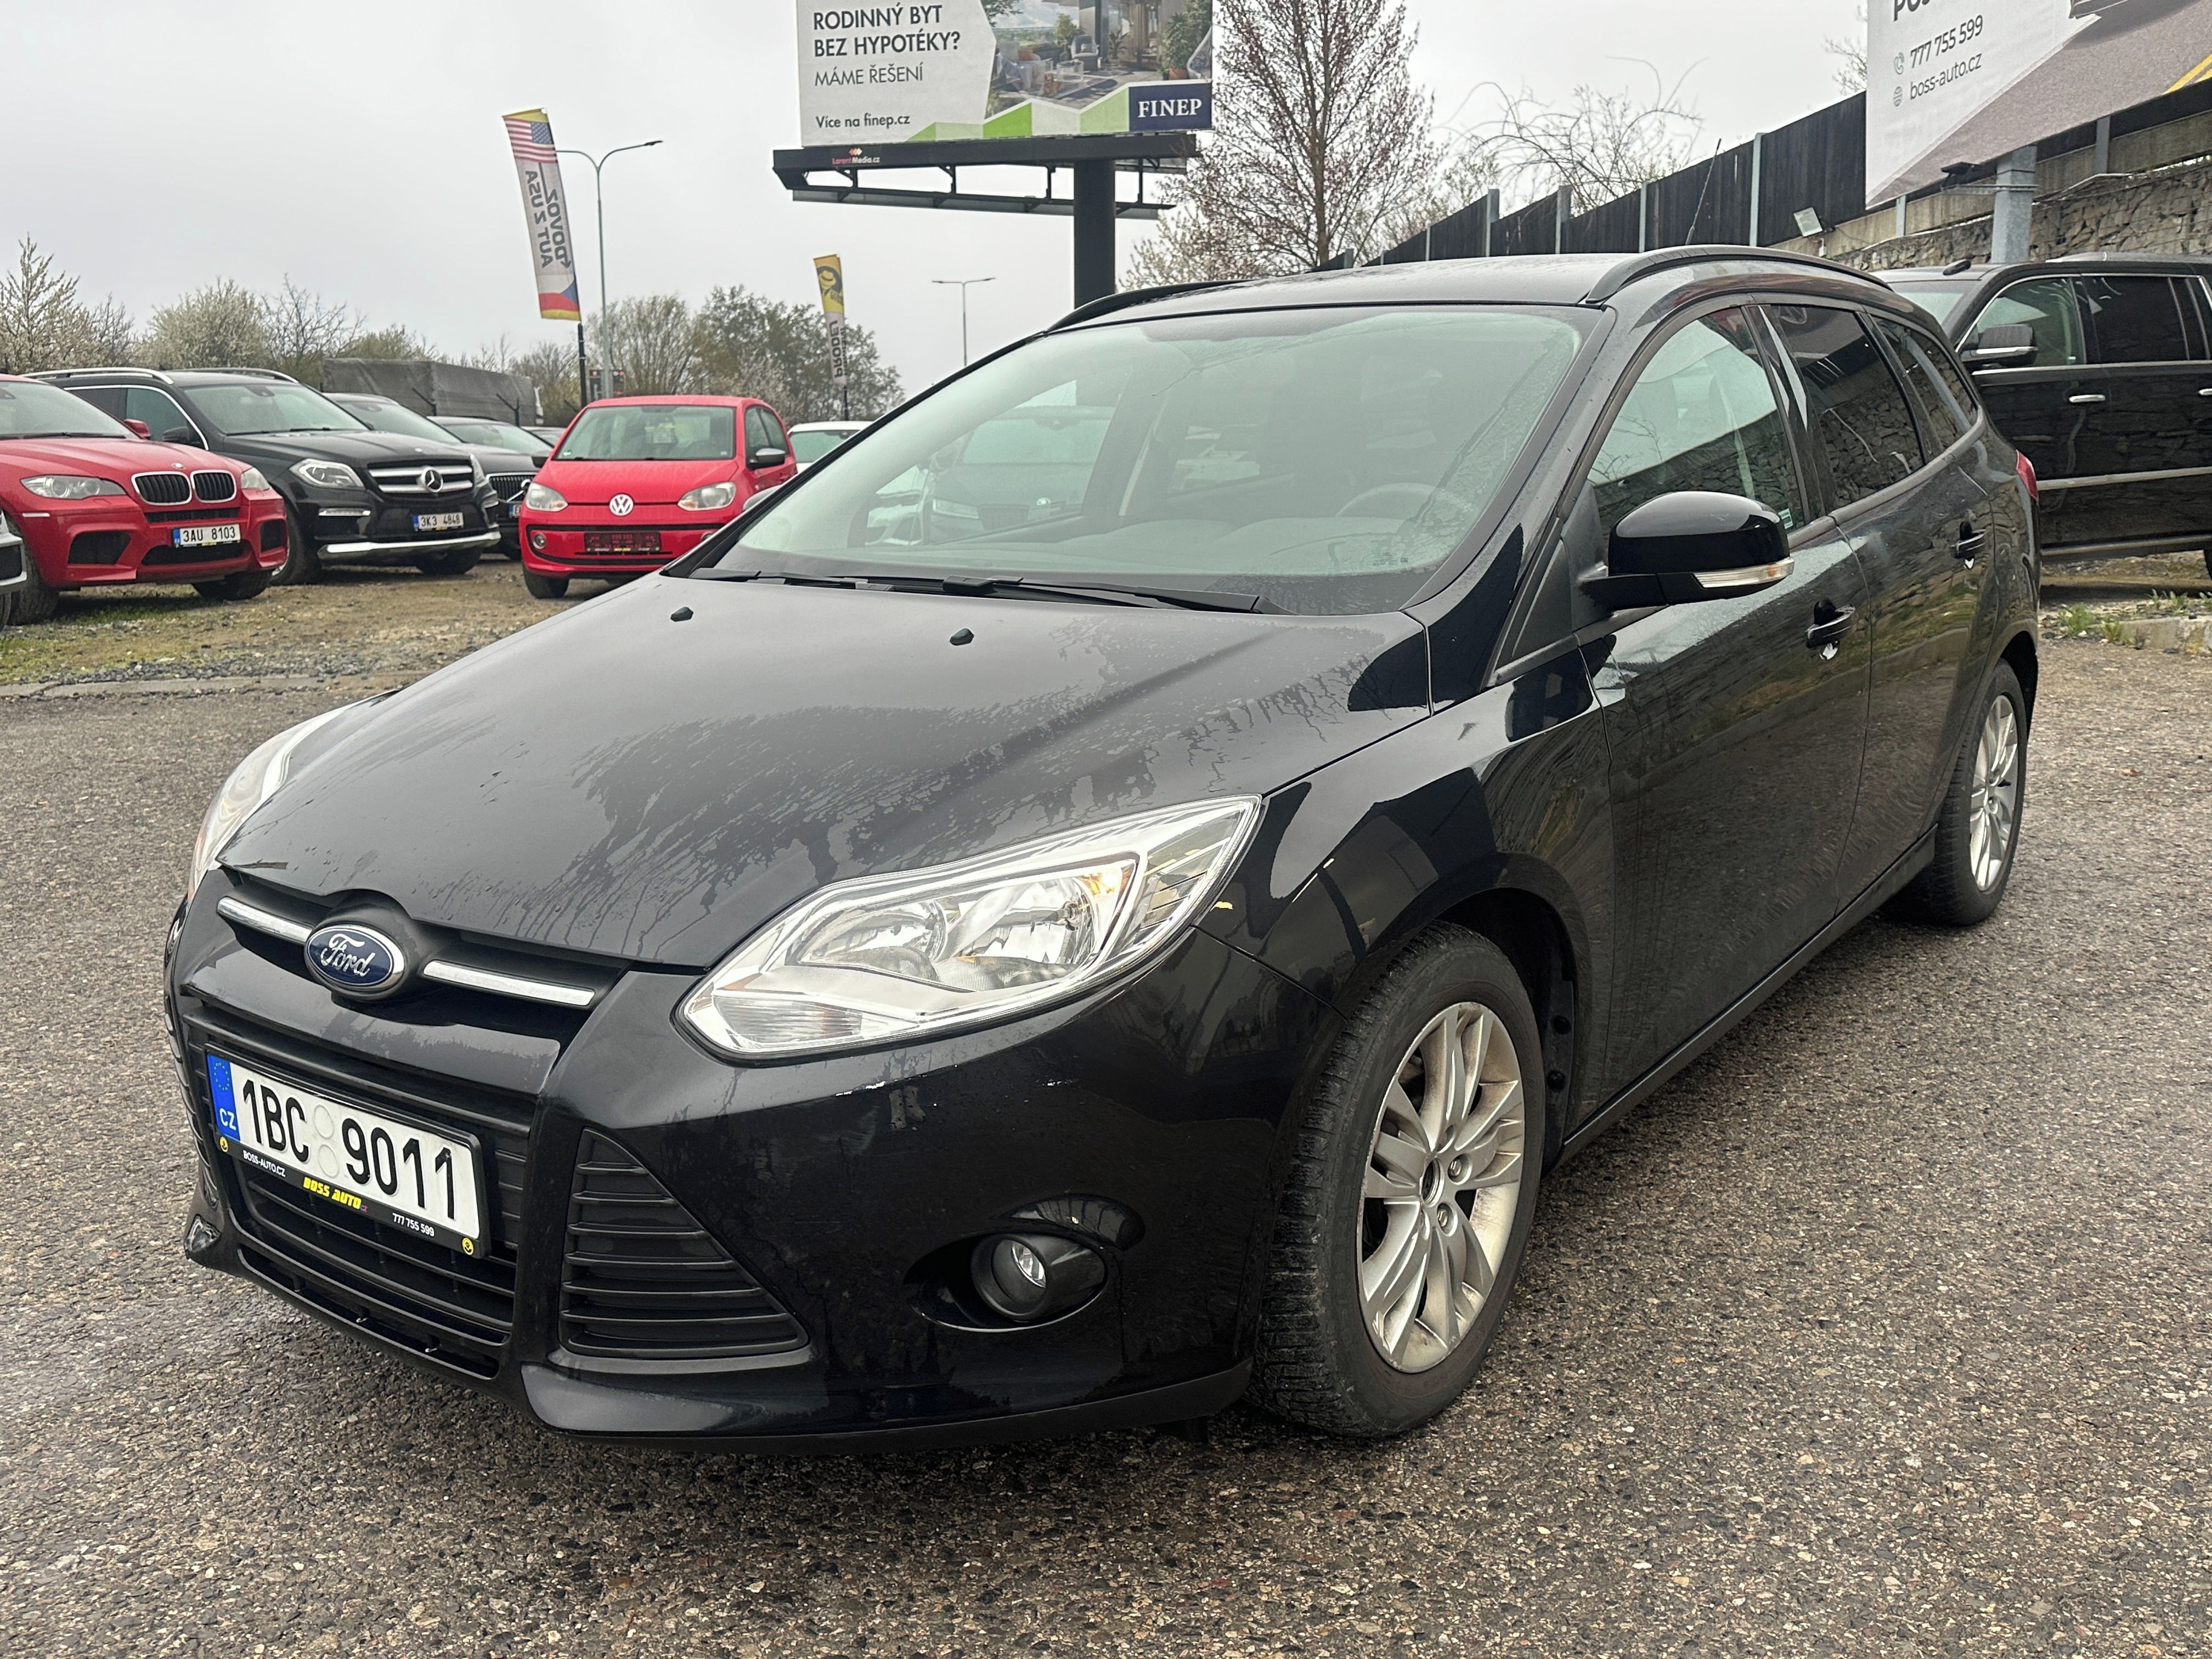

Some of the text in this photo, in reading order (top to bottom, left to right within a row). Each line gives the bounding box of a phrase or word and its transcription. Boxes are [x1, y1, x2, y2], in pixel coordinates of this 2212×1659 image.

[814, 2, 942, 30] RODINNÝ BYT
[815, 28, 961, 57] BEZ HYPOTÉKY?
[1910, 15, 1983, 69] 777 755 599
[815, 61, 923, 86] MÁME ŘEŠENÍ
[1910, 53, 1982, 100] boss-auto.cz
[815, 112, 910, 129] Více na finep.cz
[1138, 99, 1202, 117] FINEP
[183, 529, 203, 542] 3AU
[211, 526, 235, 540] 8103
[320, 933, 376, 977] Ford
[219, 1108, 236, 1131] CZ
[243, 1079, 454, 1220] 1BC 9011
[242, 1150, 286, 1177] BOSS-AUTO.CZ
[303, 1177, 330, 1197] BOSS
[392, 1212, 435, 1237] 777 755 599
